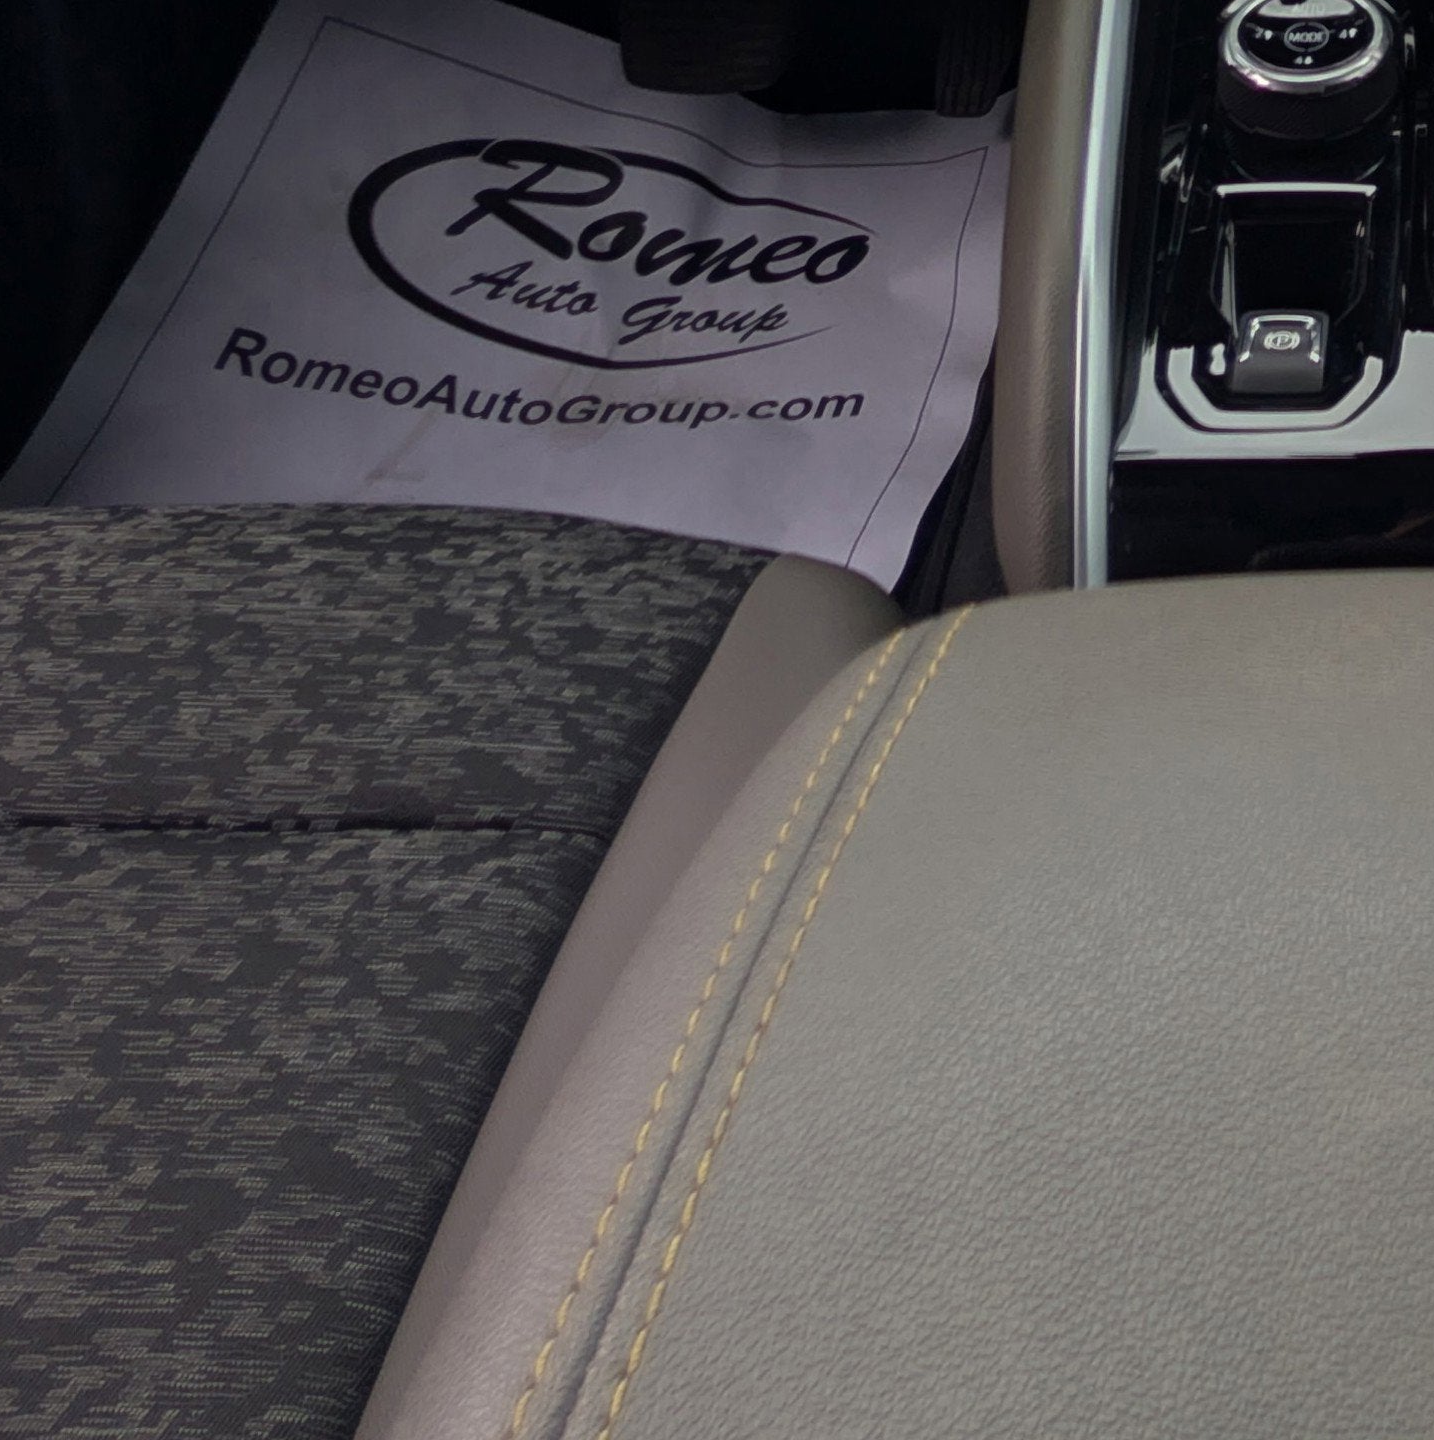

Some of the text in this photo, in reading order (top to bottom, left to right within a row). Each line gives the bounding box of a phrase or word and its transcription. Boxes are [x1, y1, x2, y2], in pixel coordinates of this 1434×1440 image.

[1288, 31, 1324, 44] MODE
[445, 140, 869, 287] Romeo
[453, 260, 788, 346] Auto Group
[214, 327, 865, 429] RomeoAutoGroup.com
